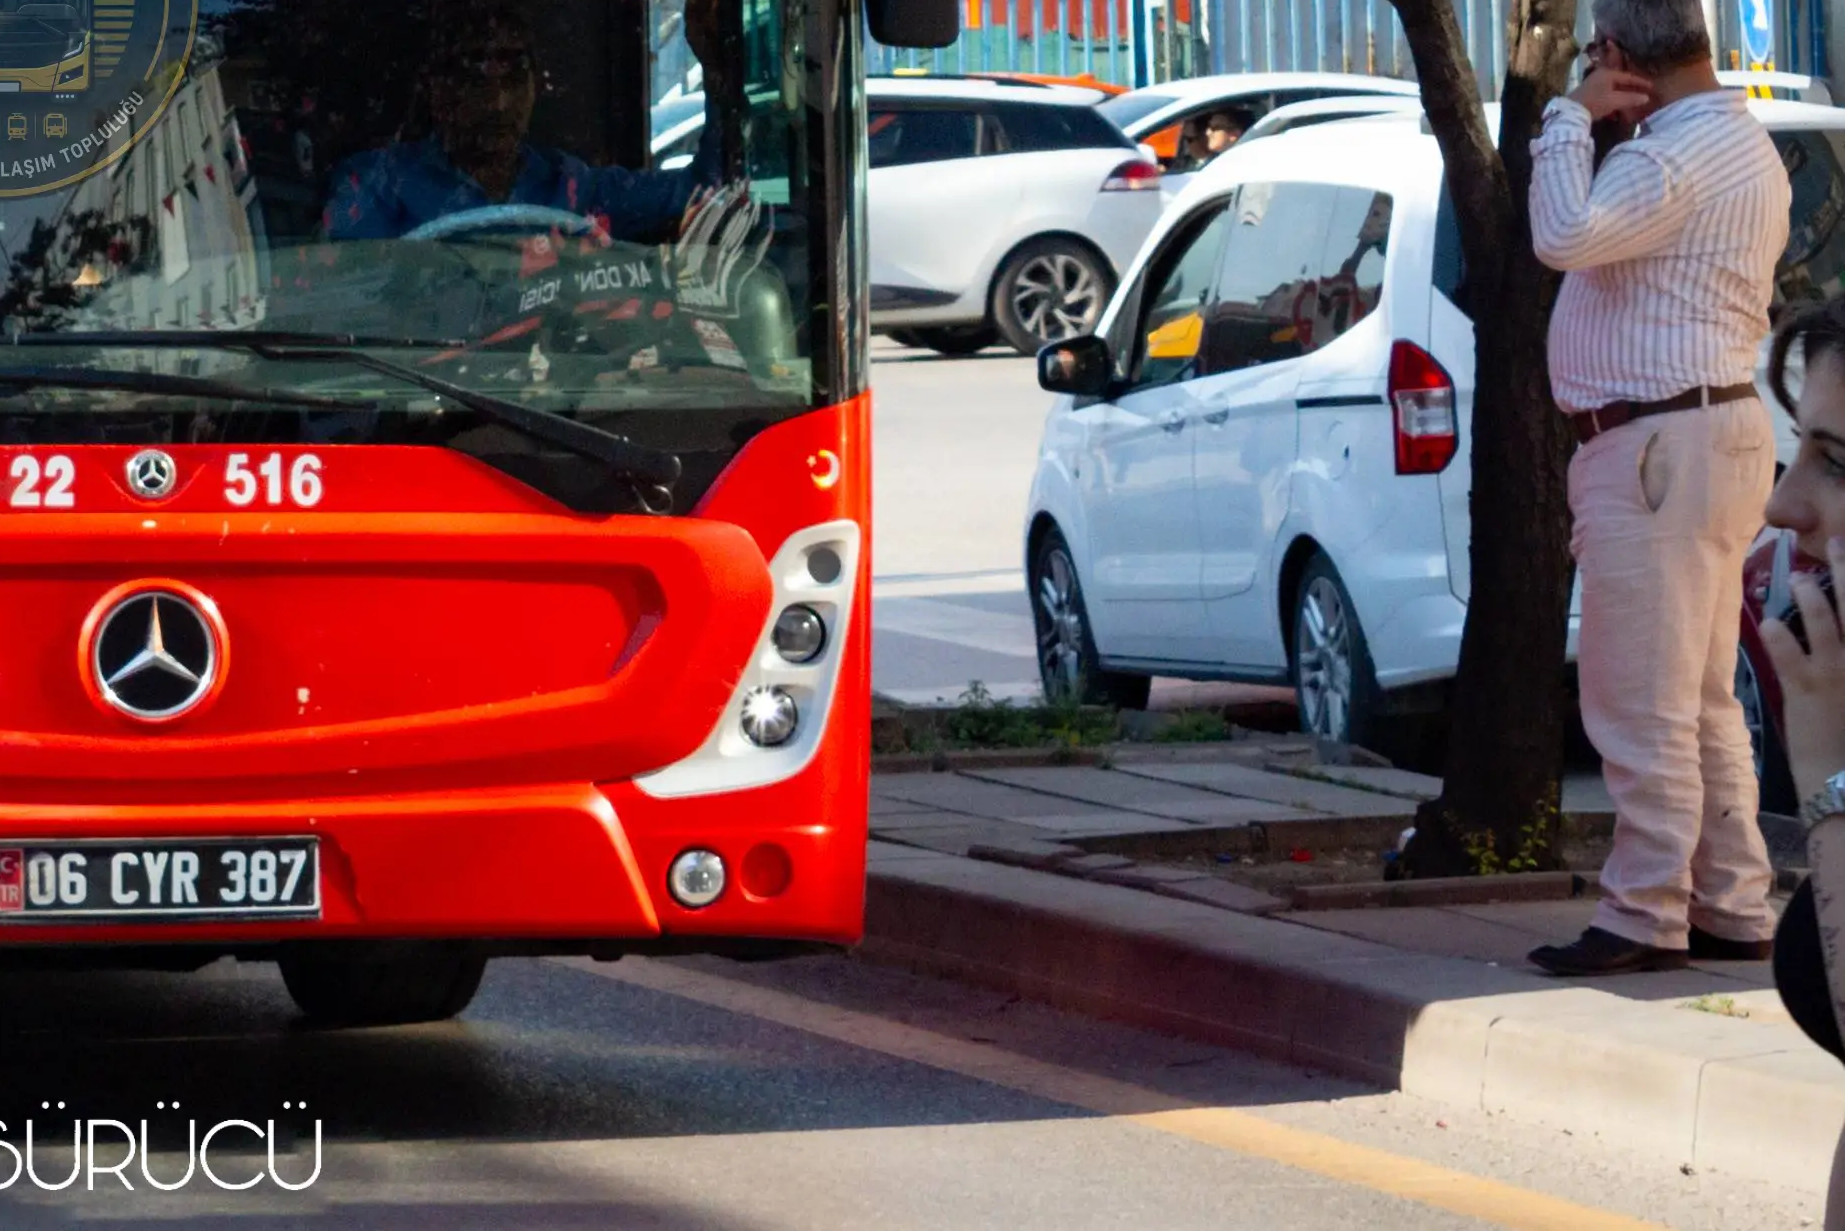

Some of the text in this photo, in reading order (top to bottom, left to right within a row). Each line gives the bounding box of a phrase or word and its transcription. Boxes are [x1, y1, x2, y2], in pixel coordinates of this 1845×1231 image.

[10, 455, 76, 507] 22
[224, 453, 323, 507] 516
[27, 849, 307, 906] 06 CYR 387
